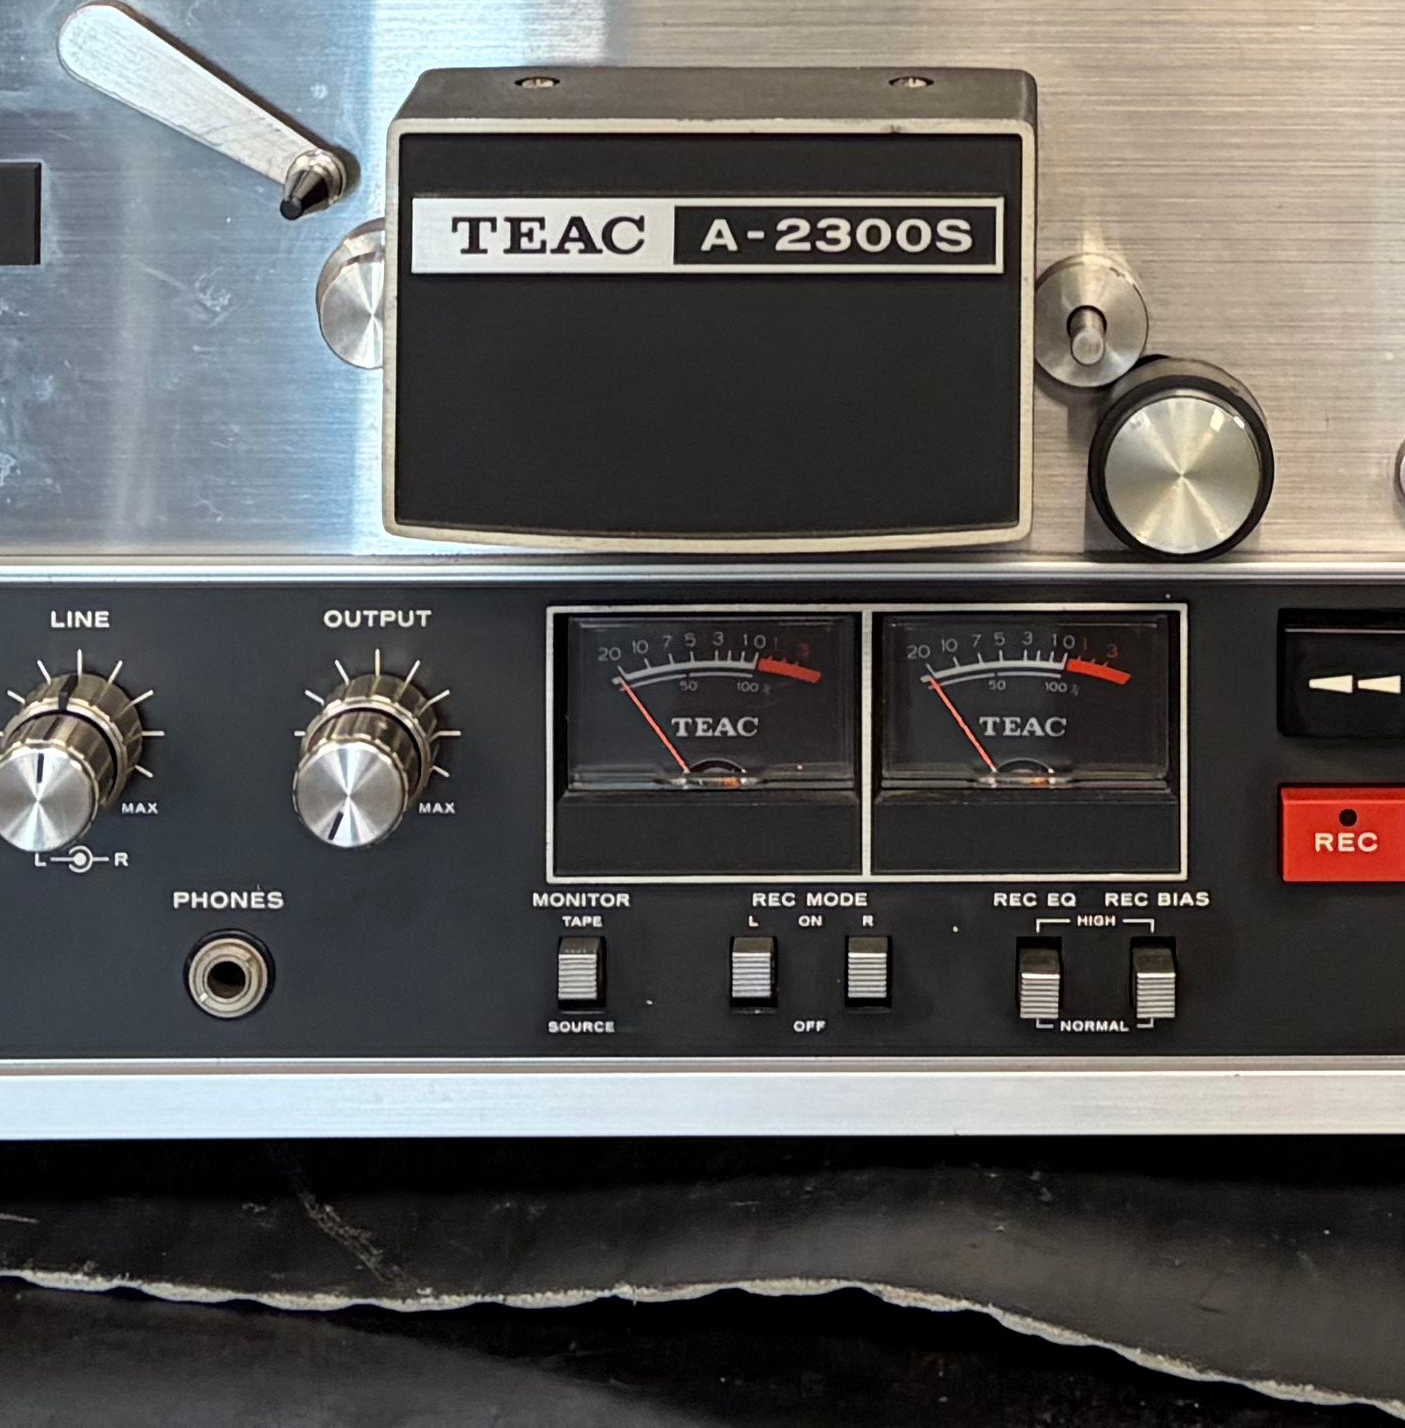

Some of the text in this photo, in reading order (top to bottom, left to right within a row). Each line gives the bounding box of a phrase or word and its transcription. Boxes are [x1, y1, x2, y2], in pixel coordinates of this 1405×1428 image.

[451, 215, 975, 255] TEAC A-2300S
[50, 610, 110, 629] LINE
[323, 609, 432, 628] OUTPUT
[597, 646, 622, 662] 20
[632, 639, 649, 655] 10
[661, 635, 673, 649] 7
[684, 632, 697, 647] 5
[712, 631, 725, 646] 3
[743, 633, 748, 646] 1
[753, 634, 767, 649] 0
[906, 644, 932, 660] 20
[941, 638, 958, 653] 10
[971, 633, 983, 647] 7
[993, 631, 1006, 646] 5
[1021, 631, 1034, 645] 3
[1052, 633, 1058, 647] 1
[1062, 634, 1076, 650] 0
[679, 679, 699, 692] 50
[737, 680, 760, 693] 100
[988, 679, 1006, 691] 50
[1045, 681, 1068, 693] 100
[671, 717, 759, 737] TEAC
[979, 716, 1067, 737] TEAC
[121, 801, 159, 815] MAX
[418, 801, 456, 815] MAX
[1315, 832, 1379, 853] REC
[34, 852, 47, 867] L
[114, 852, 129, 867] R
[173, 891, 284, 910] PHONES
[532, 892, 631, 908] MONITOR
[752, 892, 869, 907] REC MODE
[993, 892, 1077, 907] REC EQ
[1105, 891, 1211, 907] REC BIAS
[562, 915, 603, 928] TAPE
[748, 915, 874, 928] L ON R
[1077, 915, 1116, 928] HIGH
[548, 1020, 616, 1033] SOURCE
[793, 1020, 826, 1033] OFF
[1060, 1020, 1130, 1033] NORMAL
